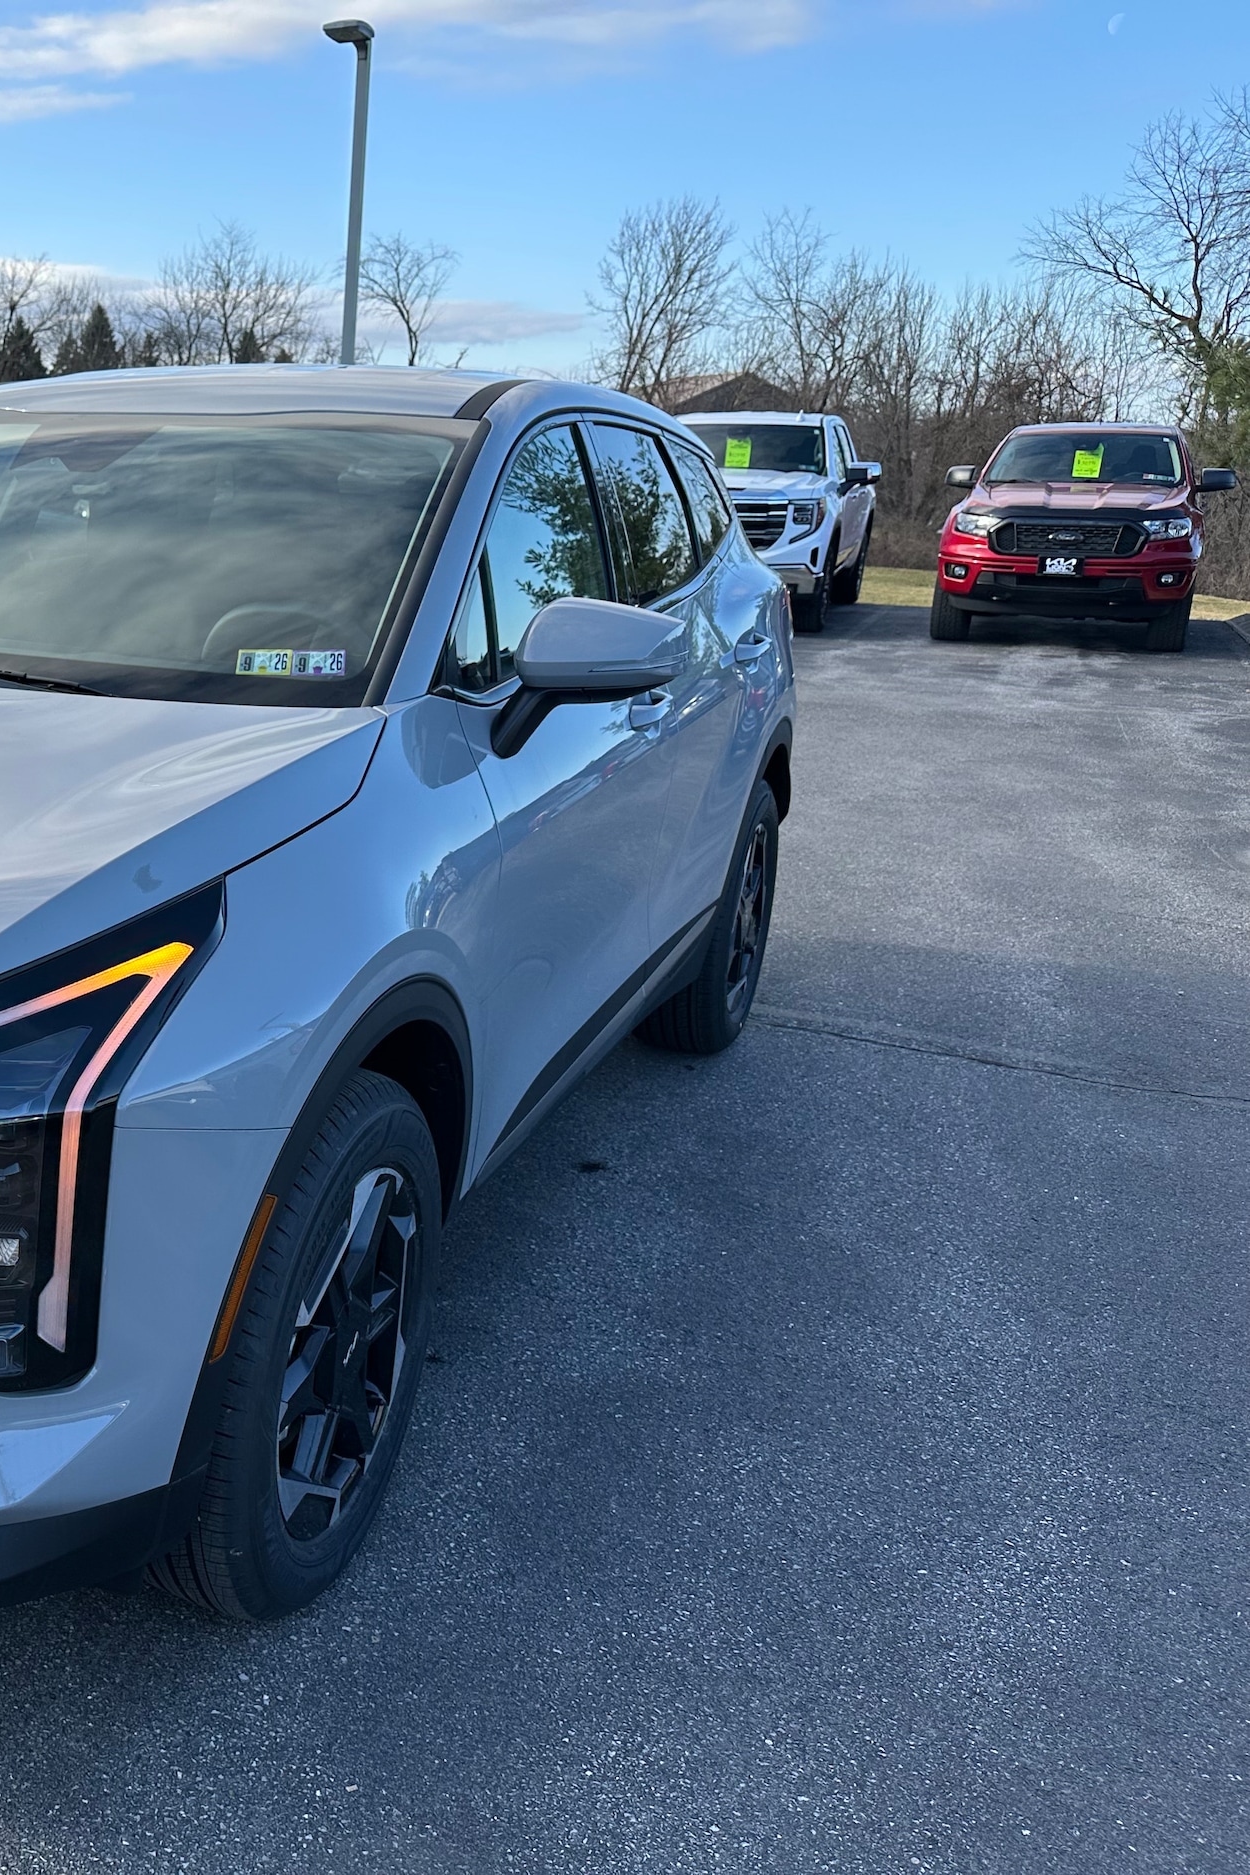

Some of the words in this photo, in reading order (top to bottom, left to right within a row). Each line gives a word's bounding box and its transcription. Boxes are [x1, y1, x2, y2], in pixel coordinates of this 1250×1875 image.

[243, 656, 252, 672] 9
[274, 653, 289, 670] 26
[298, 657, 307, 673] 9
[329, 653, 343, 671] 26
